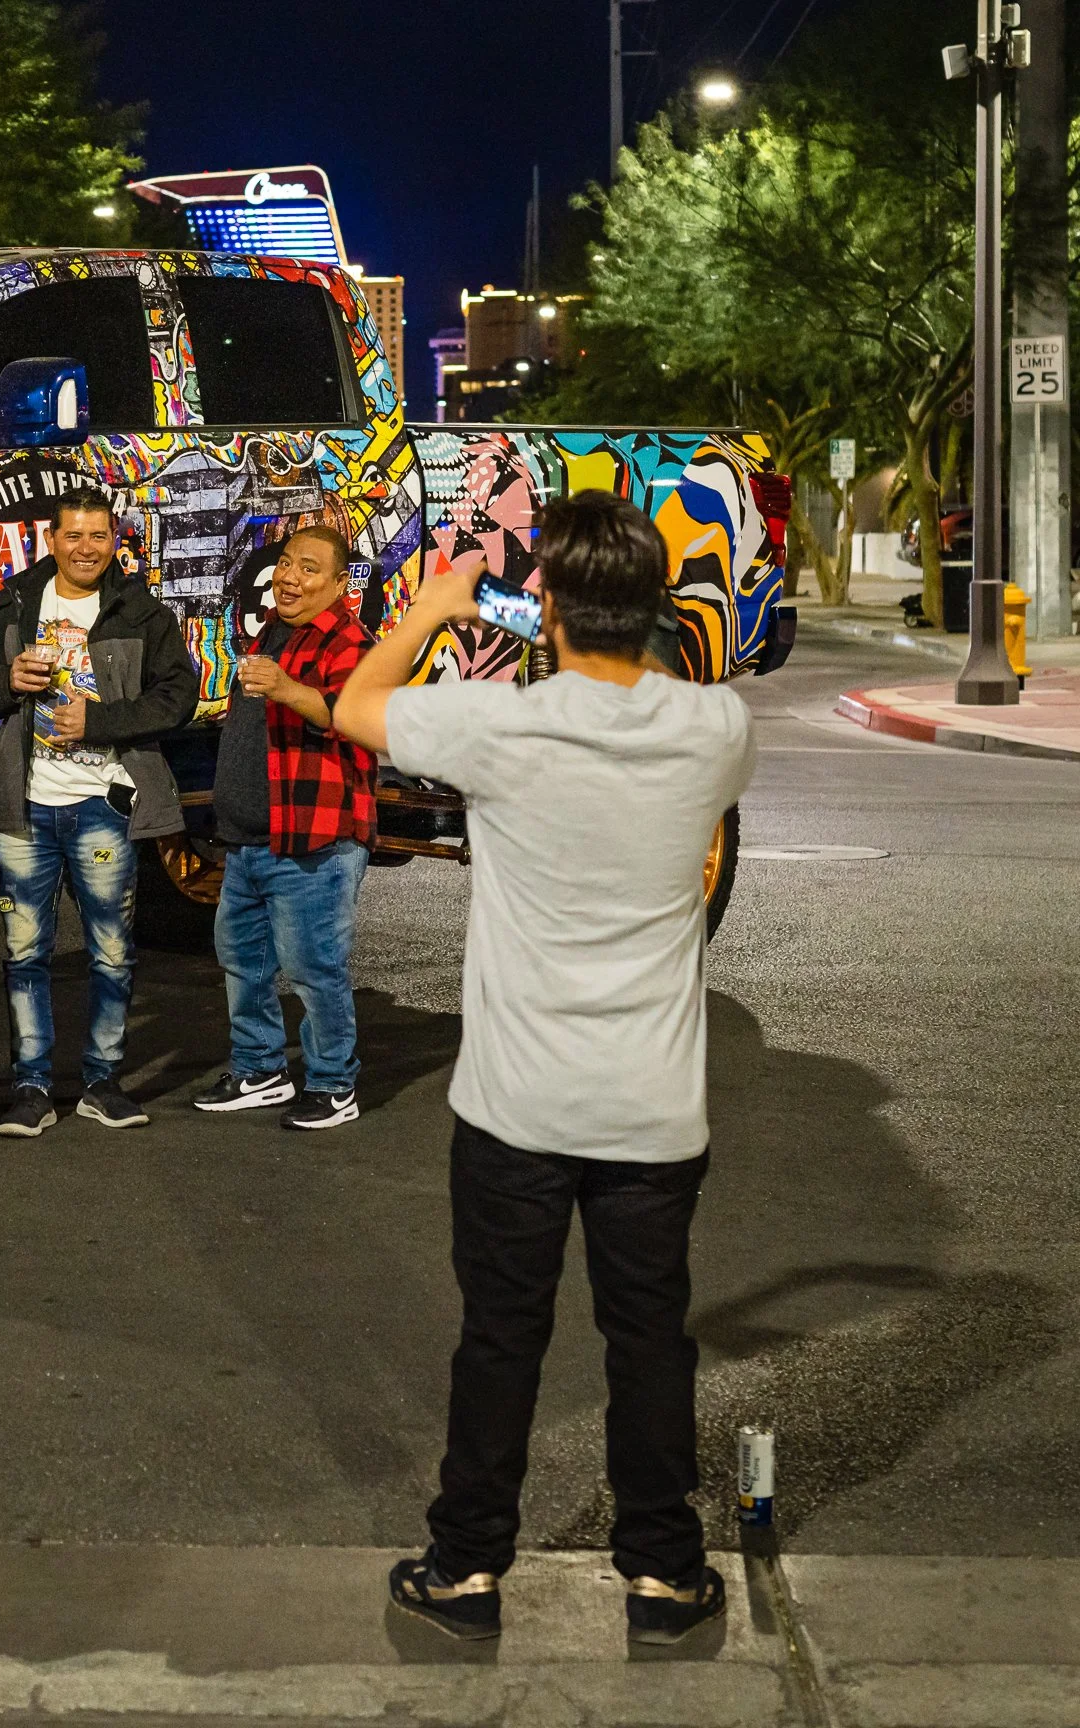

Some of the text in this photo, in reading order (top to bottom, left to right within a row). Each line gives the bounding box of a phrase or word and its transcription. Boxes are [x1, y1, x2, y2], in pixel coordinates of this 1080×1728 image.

[1015, 344, 1059, 354] SPEED
[1020, 357, 1053, 368] LIMIT
[1017, 371, 1059, 395] 25
